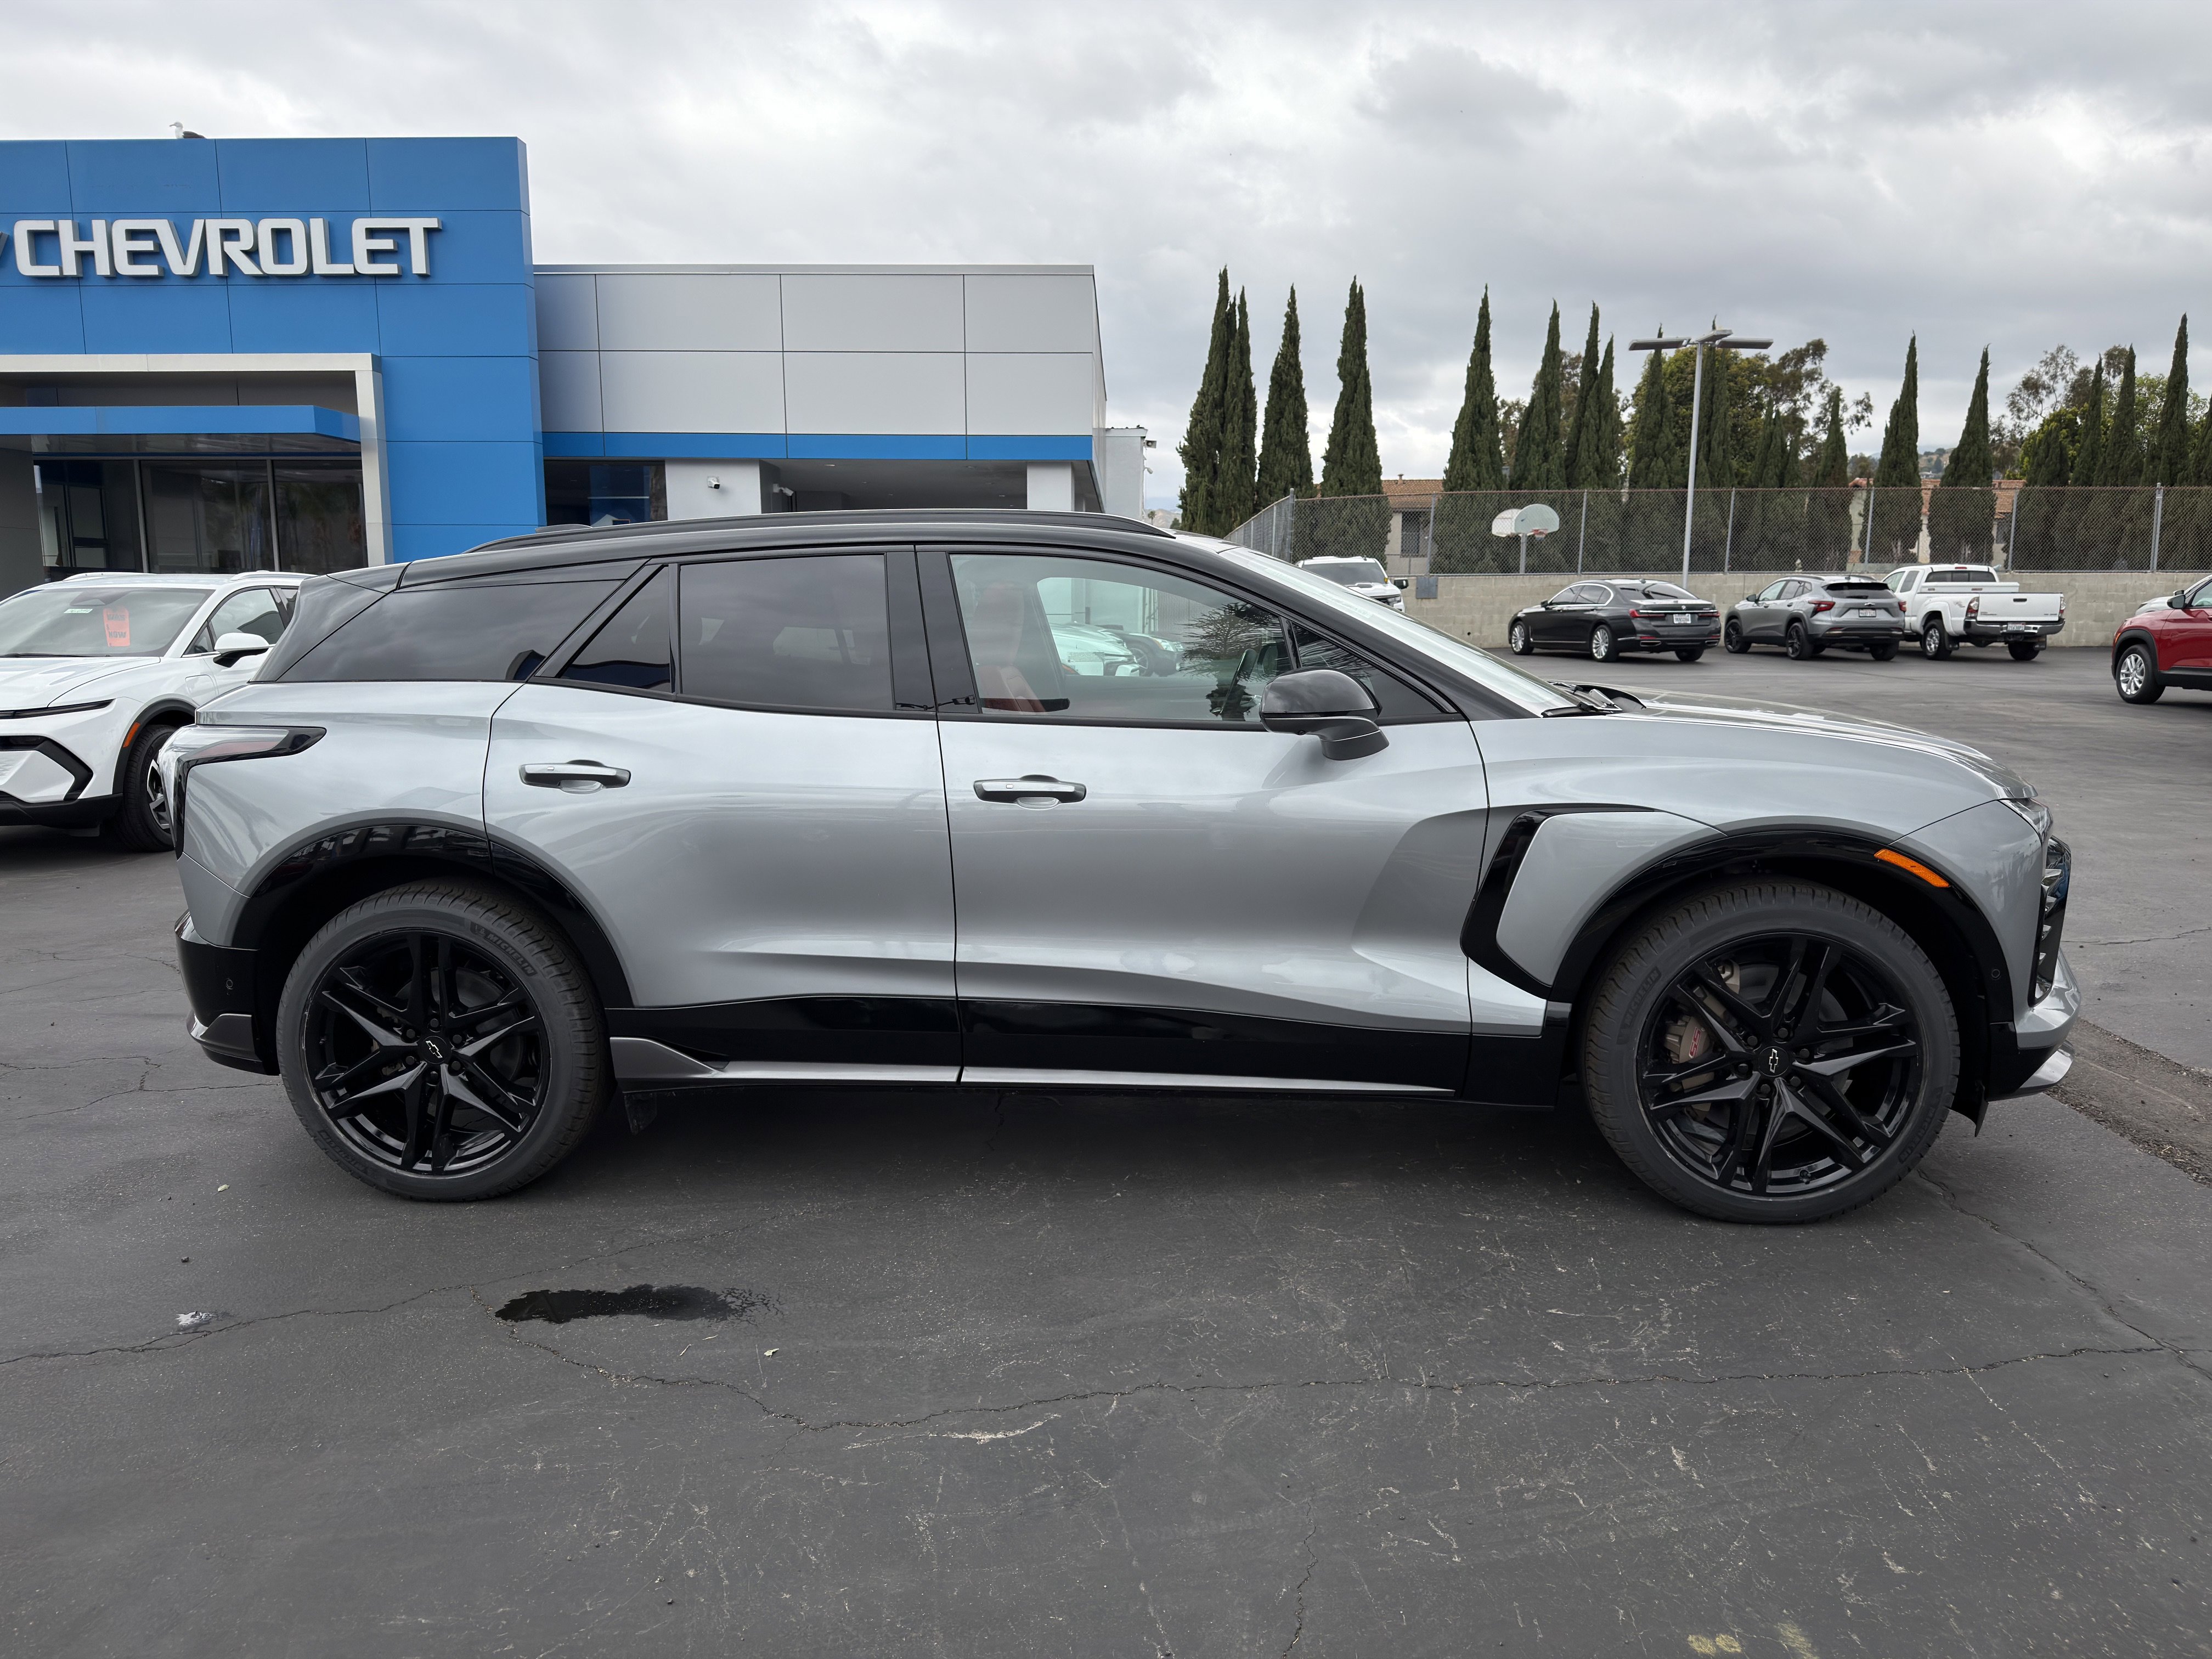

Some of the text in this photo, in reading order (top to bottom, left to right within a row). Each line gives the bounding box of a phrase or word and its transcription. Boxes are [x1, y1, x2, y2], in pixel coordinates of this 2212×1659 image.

[14, 218, 442, 277] CHEVROLET
[487, 934, 534, 975] MICHELIN
[1624, 969, 1659, 1026] MICHELIN
[1689, 1027, 1701, 1058] SS
